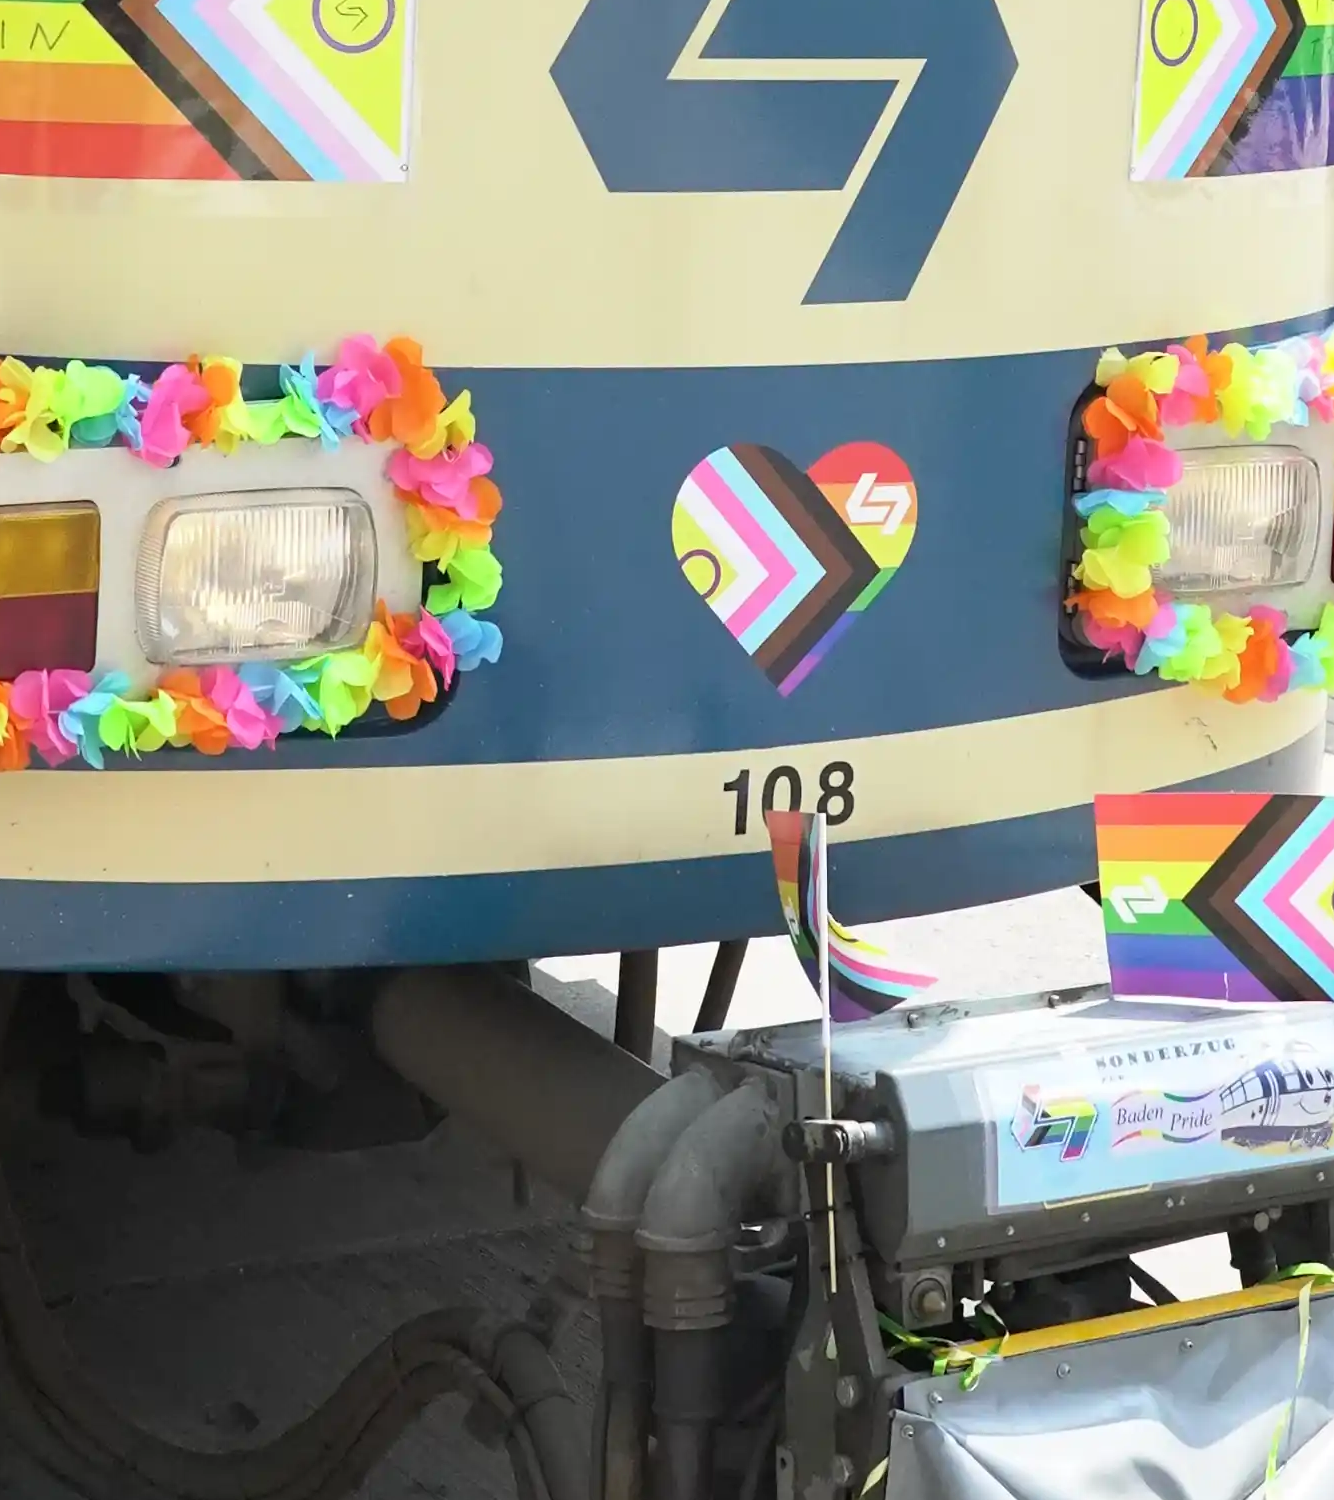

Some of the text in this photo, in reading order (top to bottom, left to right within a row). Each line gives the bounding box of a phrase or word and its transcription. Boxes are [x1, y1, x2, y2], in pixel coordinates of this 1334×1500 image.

[723, 761, 855, 835] 108
[1094, 1036, 1237, 1071] SONDERZUG
[1115, 1104, 1214, 1133] Baden Pride
